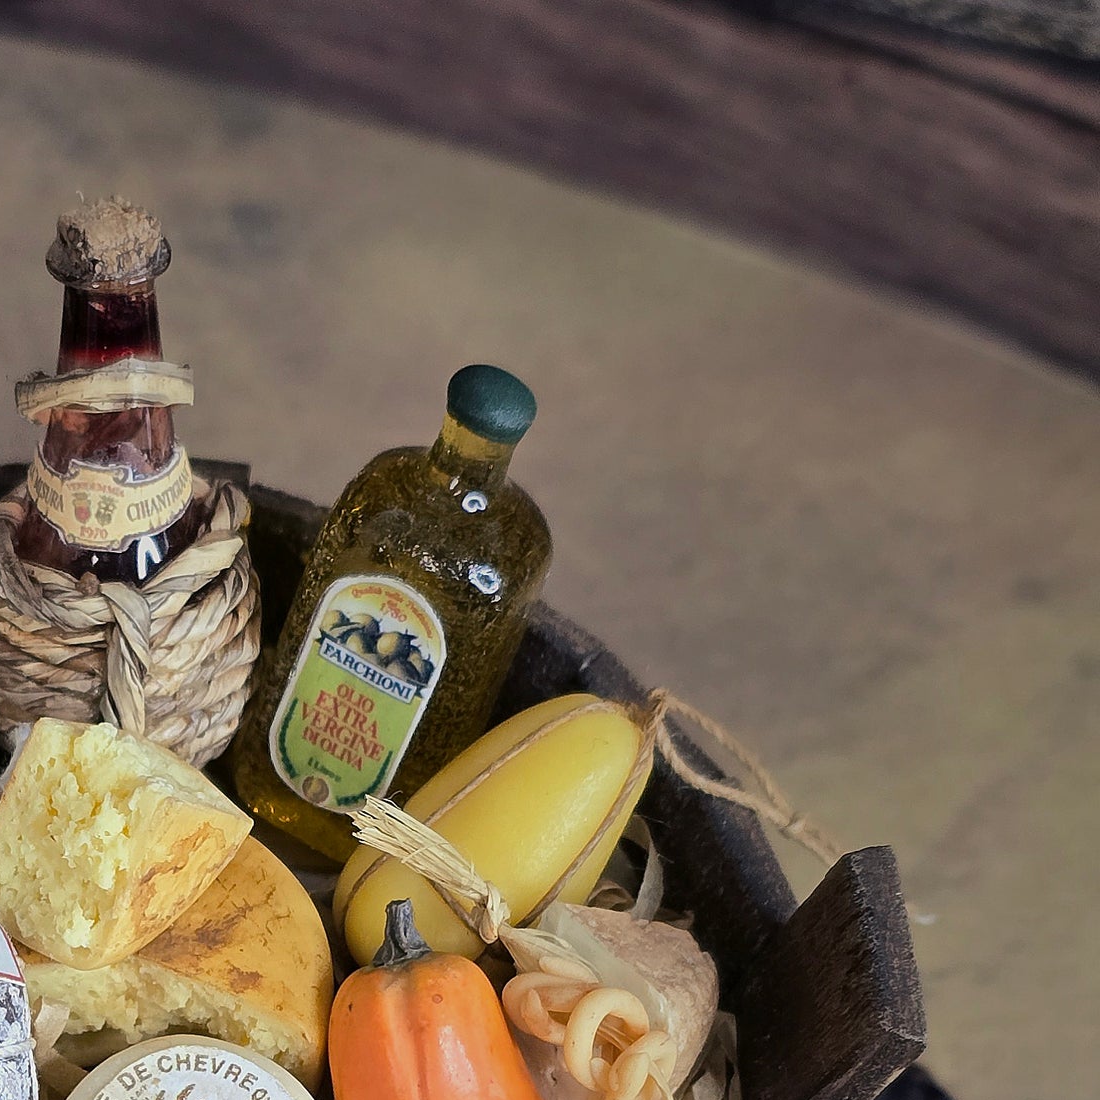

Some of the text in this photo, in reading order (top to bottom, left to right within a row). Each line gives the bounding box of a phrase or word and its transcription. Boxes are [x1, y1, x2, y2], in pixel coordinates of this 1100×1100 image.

[323, 642, 413, 699] FARCHIONI
[315, 689, 379, 739] EXTRA
[336, 683, 375, 714] OLIO
[301, 701, 385, 761] VERGINE
[301, 726, 364, 772] DI OLIVA
[118, 1062, 152, 1092] DE
[156, 1053, 260, 1092] CHEVRE
